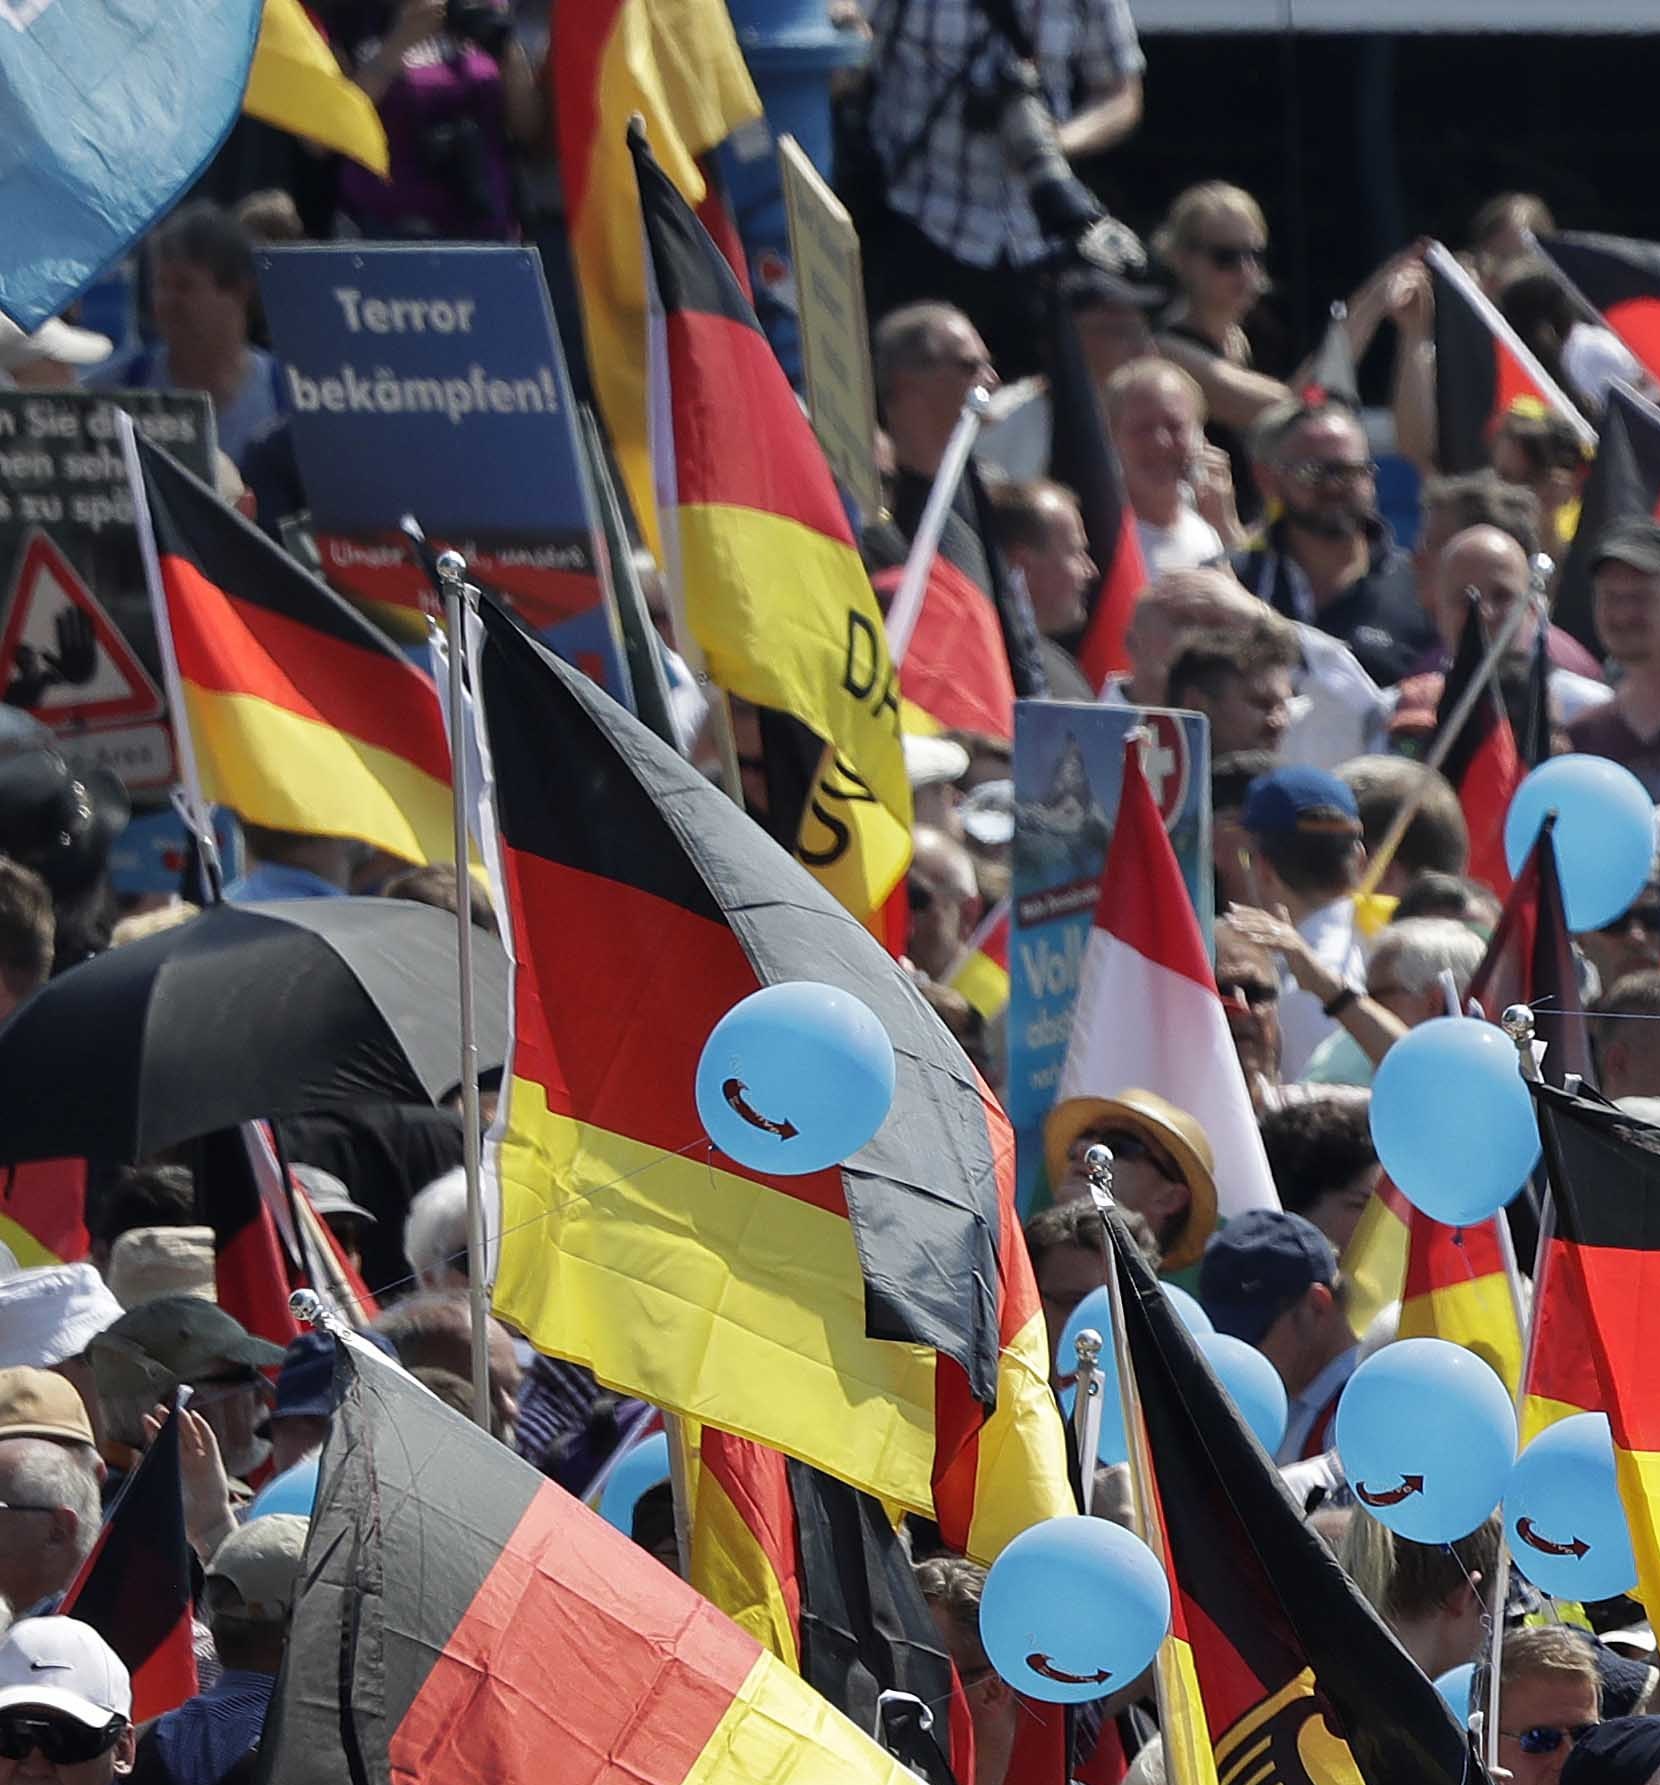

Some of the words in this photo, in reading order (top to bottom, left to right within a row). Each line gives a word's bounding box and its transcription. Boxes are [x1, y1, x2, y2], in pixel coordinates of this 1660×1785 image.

[333, 288, 476, 333] Terror
[286, 362, 559, 424] bekämpfen!
[72, 493, 135, 531] spä
